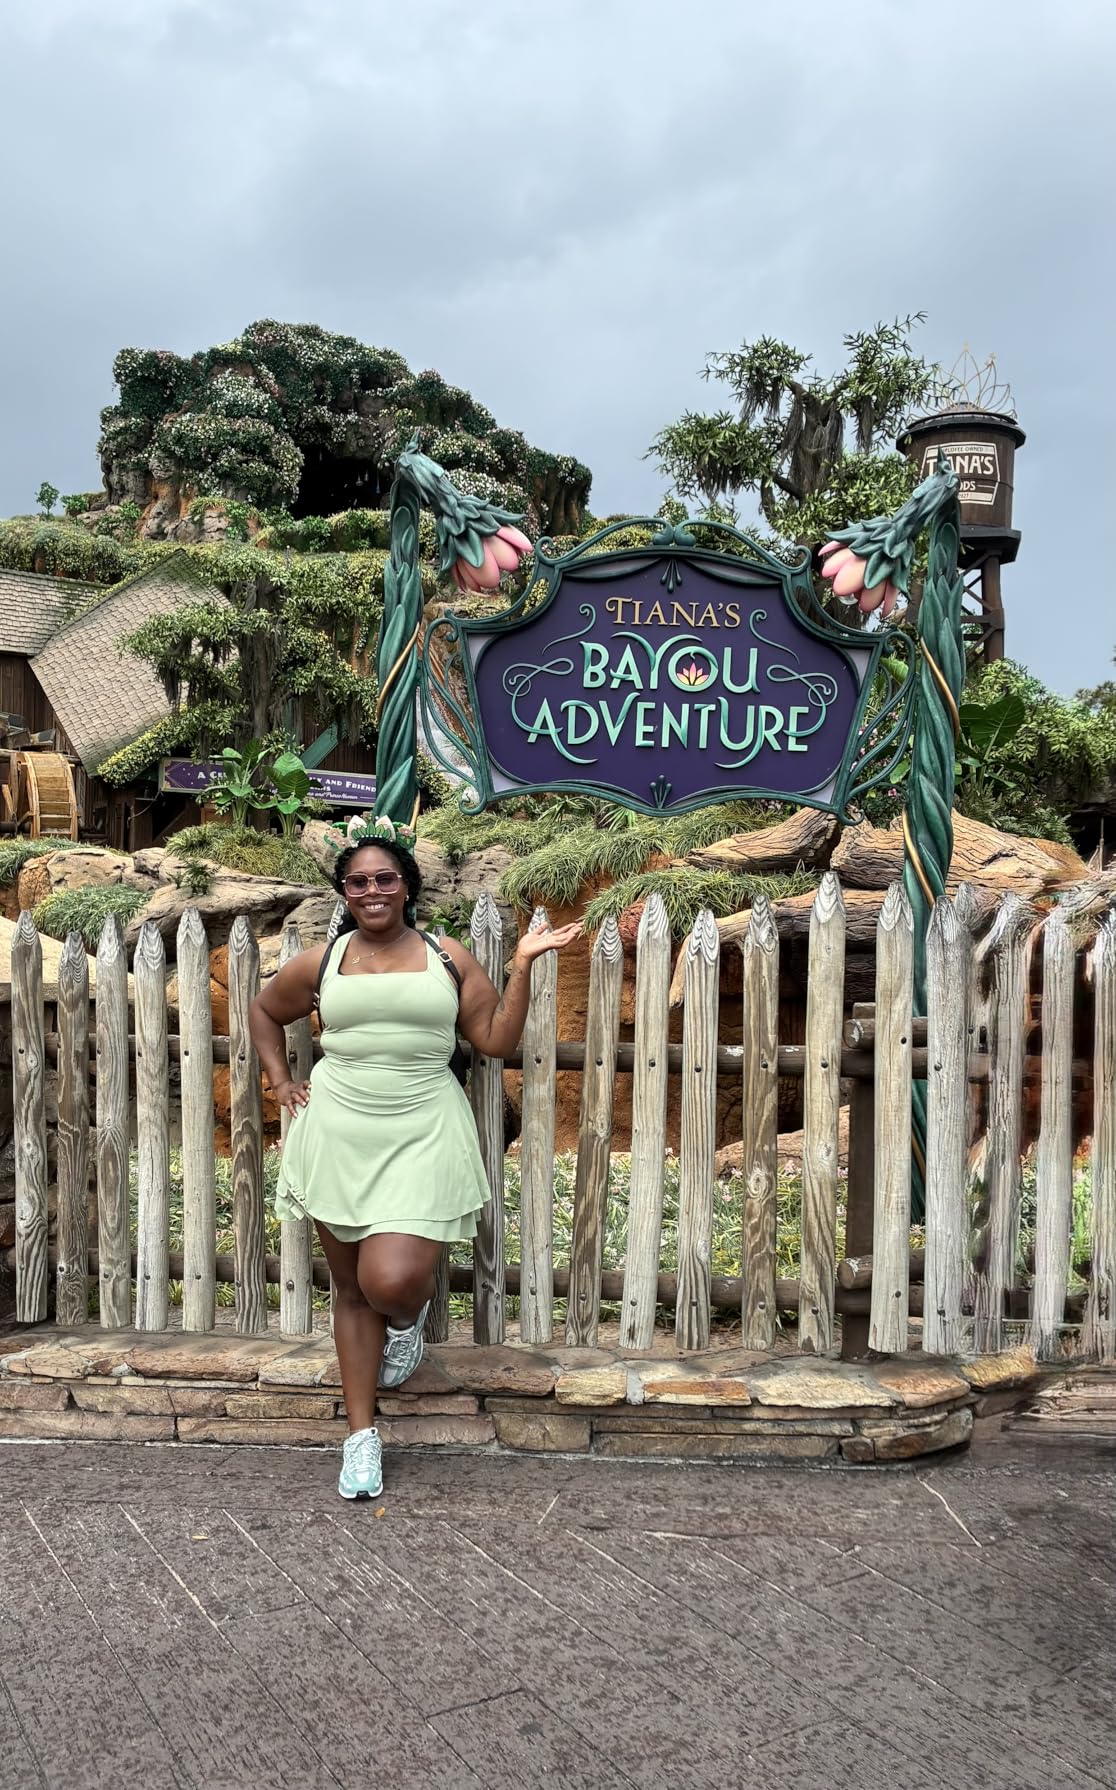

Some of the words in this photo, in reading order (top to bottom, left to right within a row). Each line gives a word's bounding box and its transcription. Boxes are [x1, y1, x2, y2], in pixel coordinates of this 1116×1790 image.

[927, 455, 994, 476] TANA'S
[605, 597, 741, 628] TIANA'S
[580, 632, 760, 693] BAYOU
[527, 692, 809, 768] ADVENTURE
[345, 780, 377, 792] FRIEND
